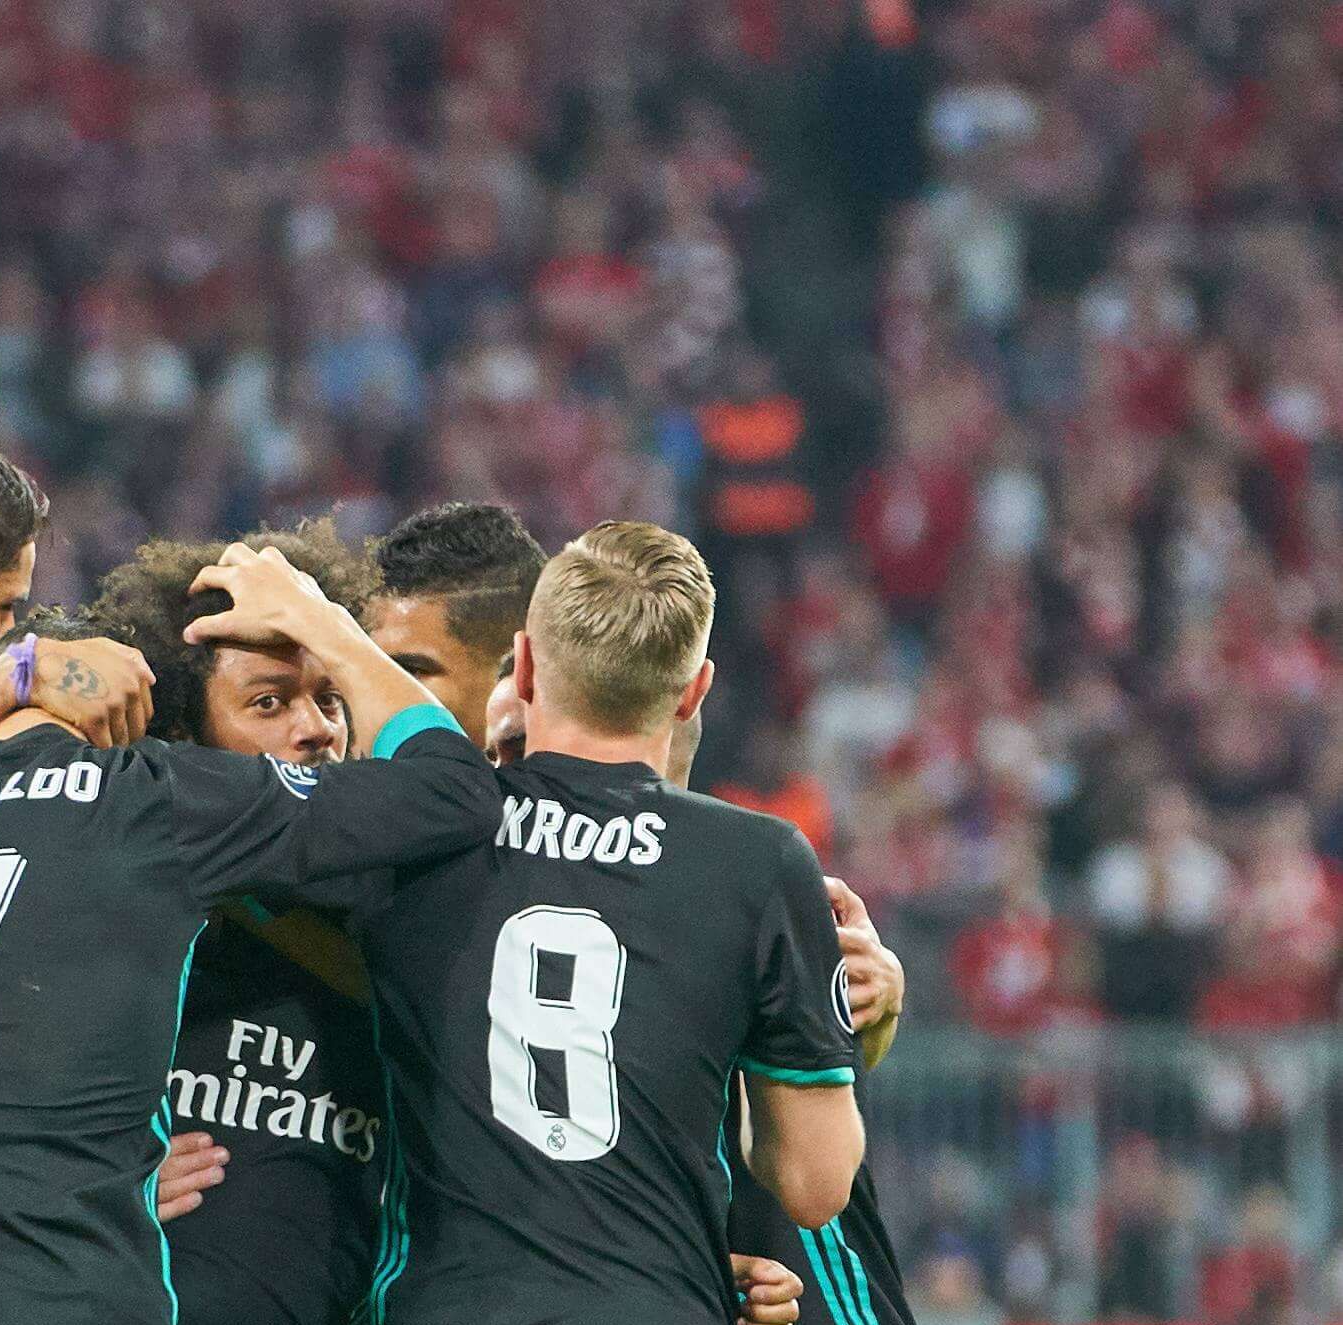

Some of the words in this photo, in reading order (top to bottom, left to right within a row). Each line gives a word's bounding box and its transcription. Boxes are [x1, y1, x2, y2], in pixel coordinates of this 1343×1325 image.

[495, 795, 667, 866] KROOS
[227, 1018, 316, 1082] Fly
[488, 904, 627, 1162] 8
[167, 1064, 381, 1162] mirates
